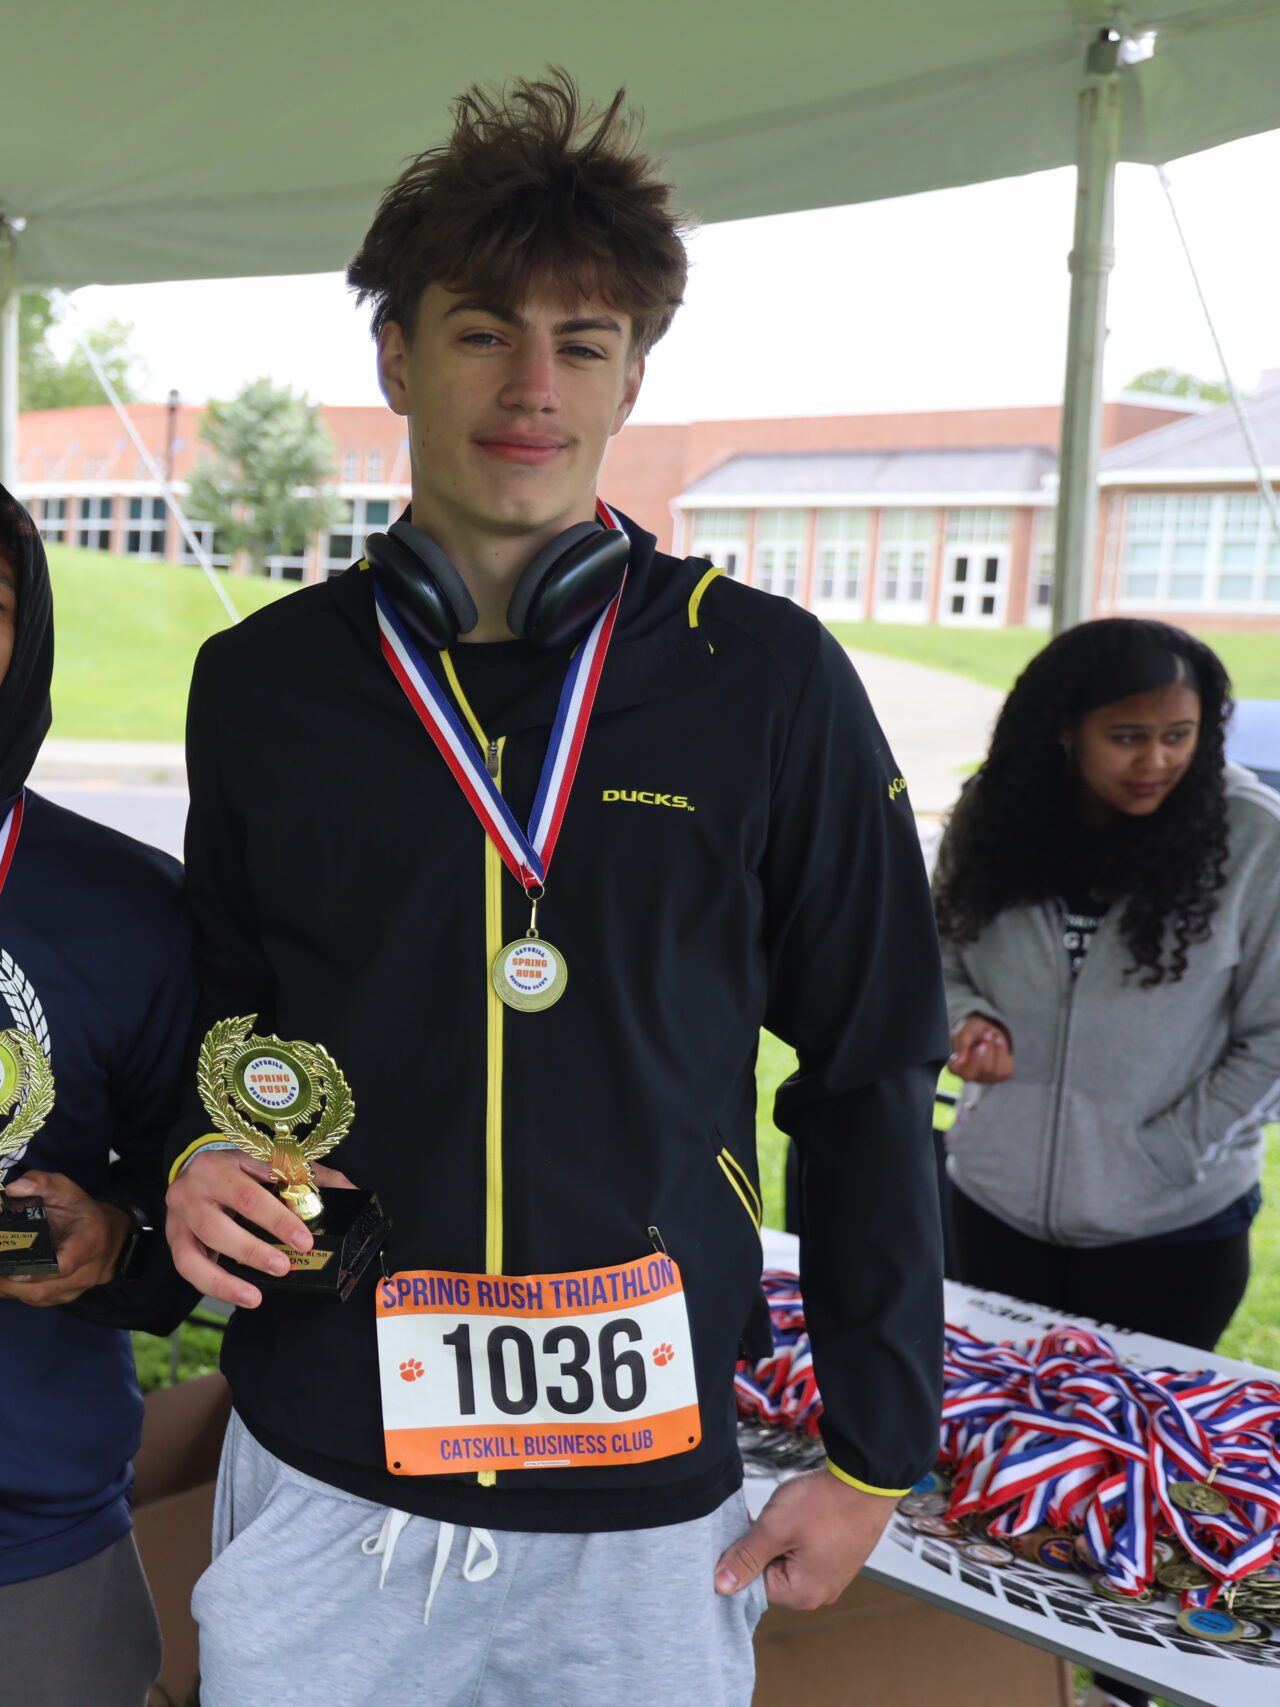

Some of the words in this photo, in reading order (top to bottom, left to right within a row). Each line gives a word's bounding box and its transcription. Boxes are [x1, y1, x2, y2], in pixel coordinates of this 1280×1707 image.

[602, 789, 688, 808] DUCKS
[515, 947, 545, 957] CATSKILL
[512, 957, 548, 968] SPRING
[516, 969, 542, 979] RUSH
[251, 1060, 283, 1070] CATSKILL
[250, 1074, 290, 1083] SPRING
[259, 1085, 288, 1093] RUSH
[382, 1277, 470, 1309] SPRING
[477, 1281, 543, 1310] RUSH
[549, 1257, 675, 1309] TRIATHLON
[443, 1317, 647, 1416] 1036
[440, 1435, 520, 1461] CATSKILL
[524, 1433, 607, 1456] BUSINESS
[611, 1429, 654, 1453] CLUB
